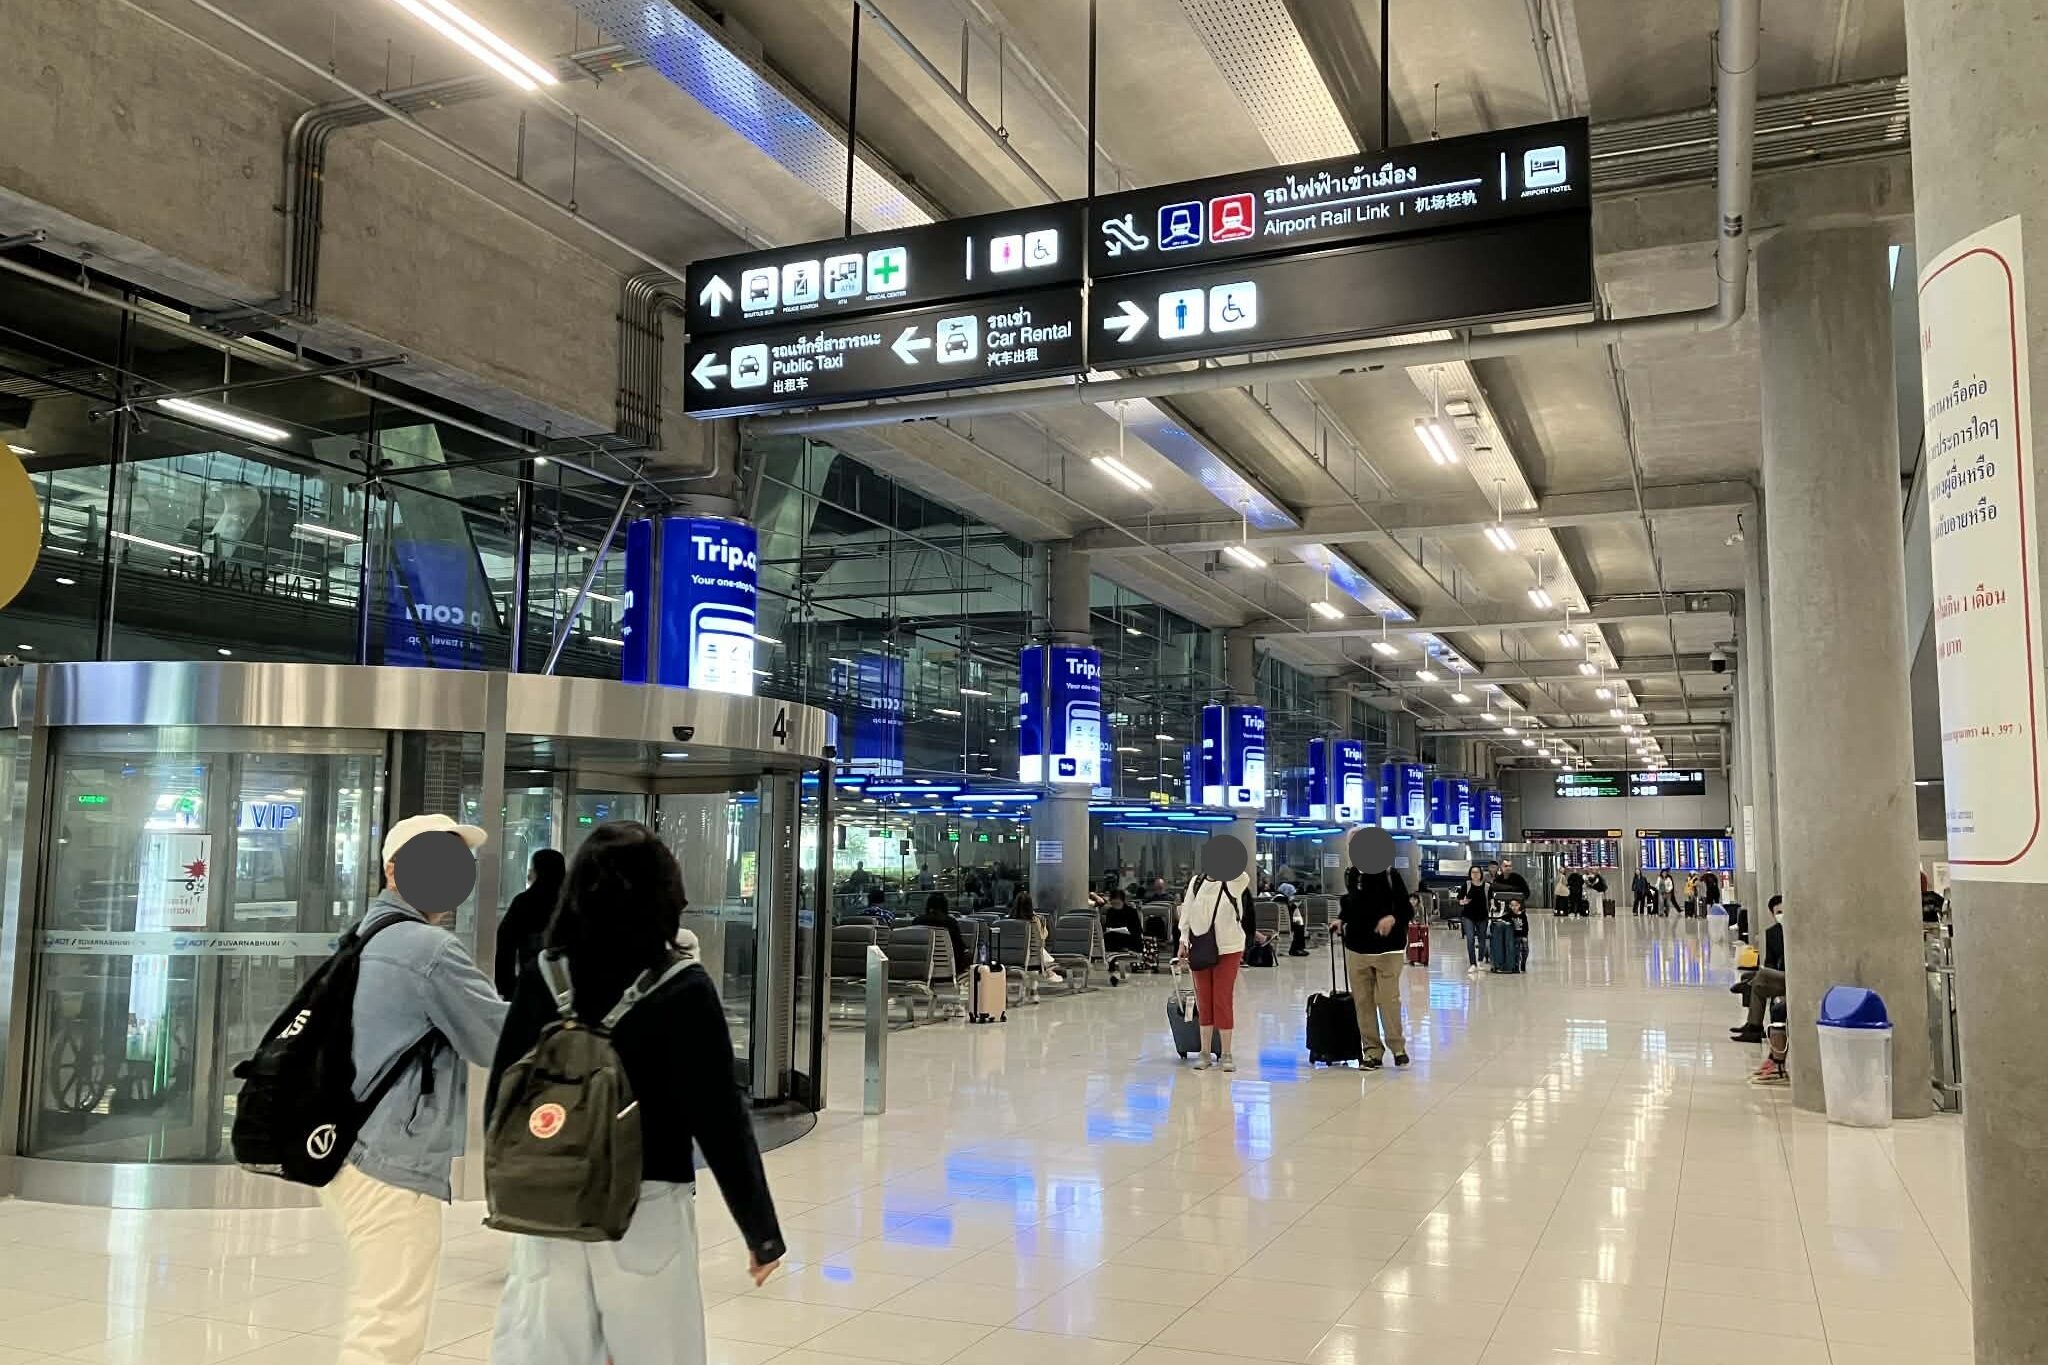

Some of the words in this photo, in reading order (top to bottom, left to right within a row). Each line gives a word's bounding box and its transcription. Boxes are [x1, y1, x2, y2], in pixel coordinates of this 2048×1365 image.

[1263, 162, 1417, 204] รถไฟฟ้าเข้าเมือง
[1520, 187, 1549, 198] AIRPORT
[1550, 184, 1573, 194] HOTEL
[1414, 189, 1478, 214] 机场轻轨
[1263, 214, 1317, 236] Airport
[1320, 208, 1351, 227] Rail
[1356, 202, 1390, 222] Link
[986, 306, 1032, 329] รถเช่า
[771, 330, 881, 358] รถแท็กซี่สาธารณะ
[986, 330, 1017, 348] Car
[1020, 320, 1072, 344] Rental
[773, 357, 814, 376] Public
[815, 353, 843, 370] Taxi
[987, 347, 1039, 368] 汽车出租
[773, 377, 809, 394] 出租车
[691, 574, 716, 585] Your
[1972, 582, 2007, 610] เดือน
[772, 707, 787, 745] 4
[1998, 723, 2014, 736] 397
[252, 803, 298, 831] VIP
